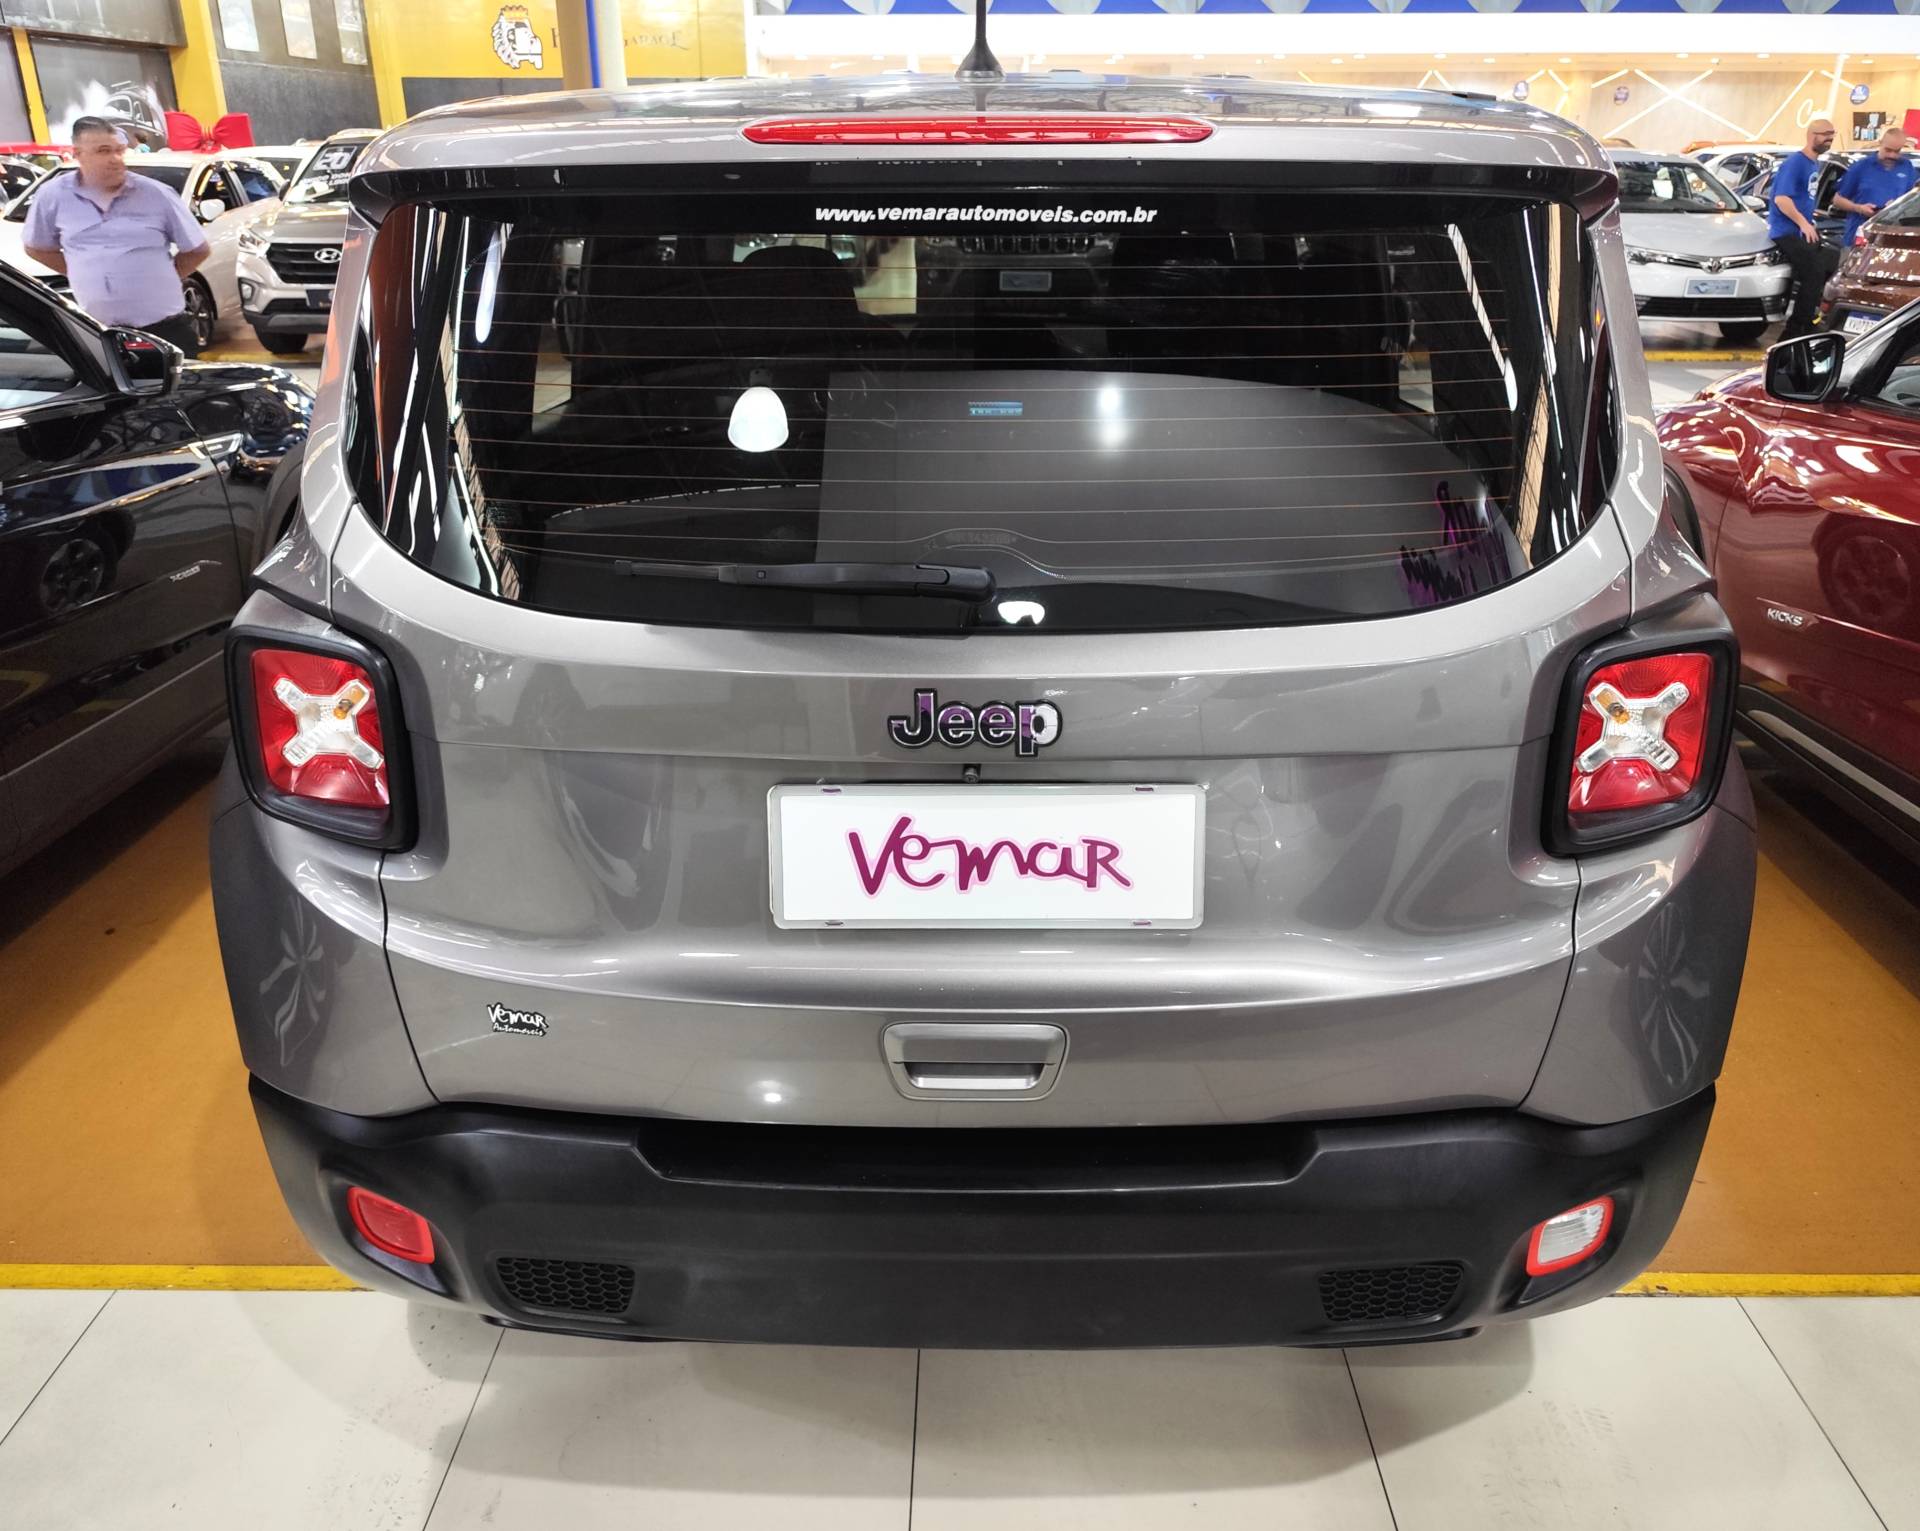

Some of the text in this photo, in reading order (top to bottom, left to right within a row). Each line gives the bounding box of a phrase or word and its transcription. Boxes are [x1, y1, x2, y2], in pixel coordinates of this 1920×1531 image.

[815, 205, 1157, 223] www.vemarautomoveis.com.br
[1767, 607, 1803, 626] KICKS
[888, 688, 1063, 757] Jeep
